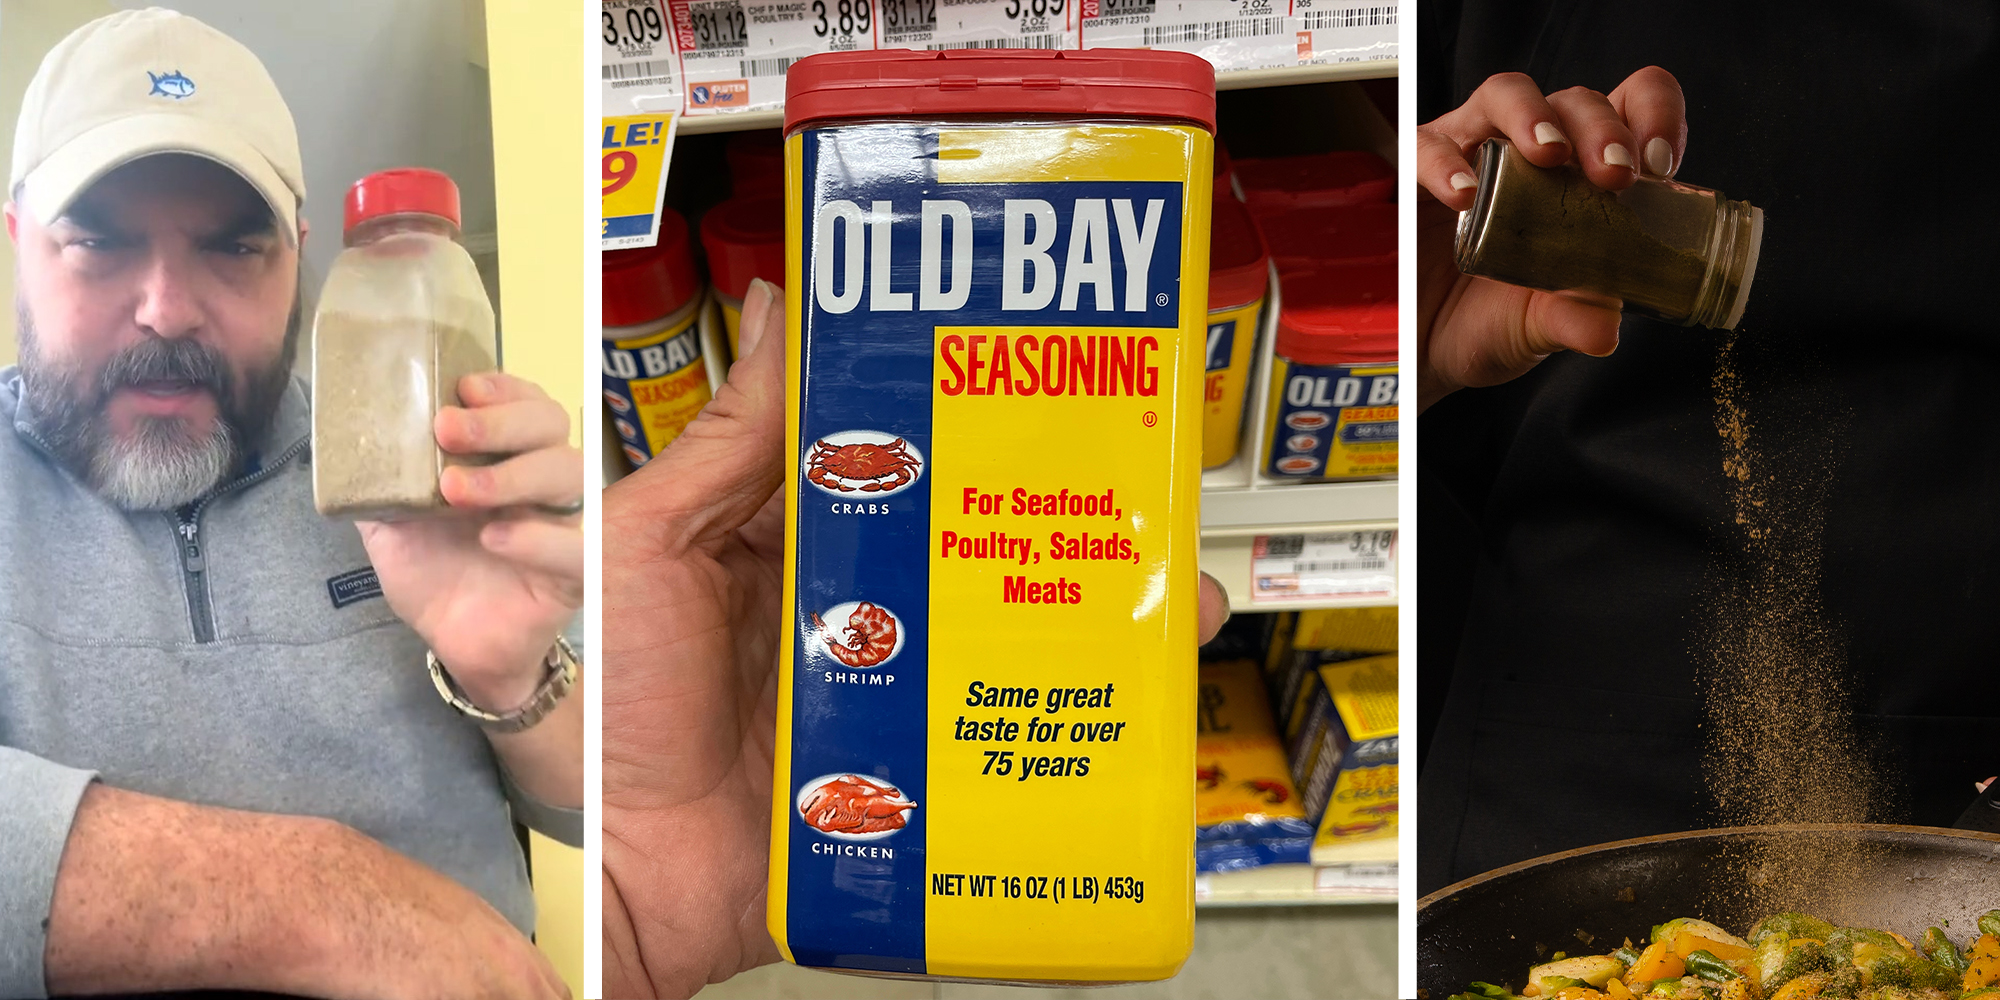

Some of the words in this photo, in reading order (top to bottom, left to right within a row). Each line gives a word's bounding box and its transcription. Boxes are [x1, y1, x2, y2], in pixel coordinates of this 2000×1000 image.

[753, 13, 796, 24] POULTRY
[812, 0, 870, 37] 3.89
[1104, 9, 1120, 17] PER
[1122, 6, 1151, 15] POUND
[1242, 1, 1249, 9] 2
[602, 7, 662, 46] 3.09
[691, 10, 748, 42] $31.12
[815, 199, 974, 314] OLD
[1002, 198, 1165, 312] BAY
[940, 334, 1160, 397] SEASONING
[1287, 375, 1362, 407] OLD
[1367, 374, 1398, 406] B
[831, 502, 890, 515] CRABS
[963, 487, 1004, 516] For
[1011, 487, 1122, 522] Seafood,
[941, 530, 1041, 566] Poultry,
[1049, 531, 1141, 565] Salads,
[1003, 575, 1082, 605] Meats
[824, 671, 895, 686] SHRIMP
[965, 681, 1039, 708] Same
[1045, 683, 1114, 714] great
[954, 716, 1019, 742] taste
[1026, 716, 1064, 742] for
[1070, 721, 1126, 742] over
[981, 750, 1014, 776] 75
[1018, 755, 1091, 782] years
[811, 842, 893, 860] CHICKEN
[932, 873, 965, 896] NET
[969, 875, 996, 898] WT
[1001, 876, 1021, 898] 16
[1025, 876, 1048, 899] OZ
[1053, 876, 1067, 904] (1
[1073, 876, 1099, 904] LB)
[1103, 876, 1144, 903] 453g
